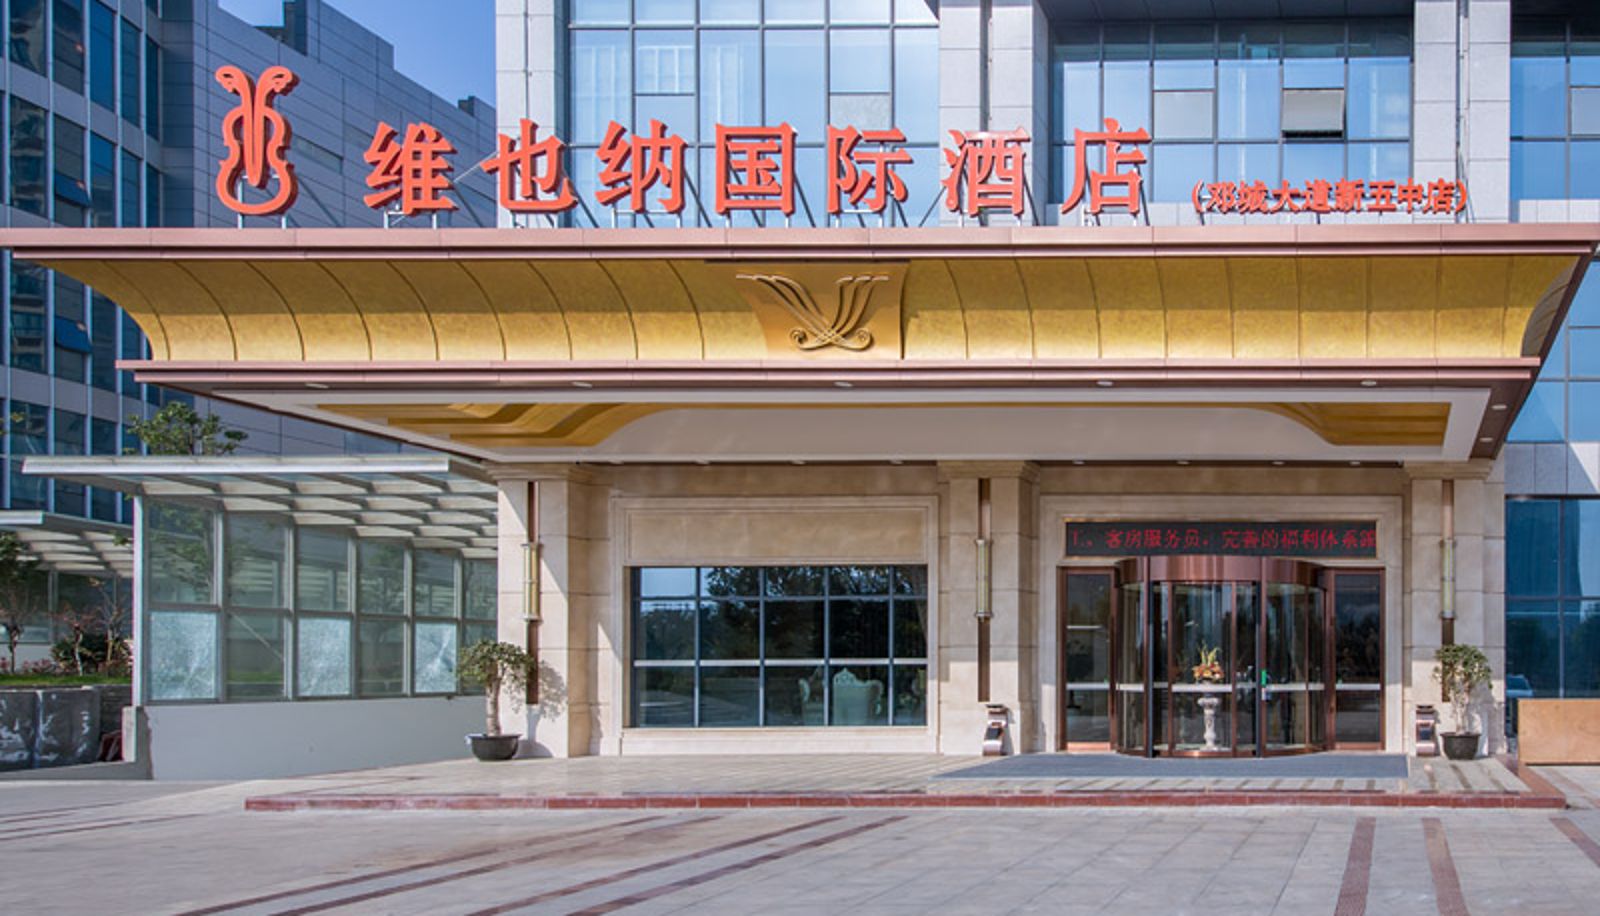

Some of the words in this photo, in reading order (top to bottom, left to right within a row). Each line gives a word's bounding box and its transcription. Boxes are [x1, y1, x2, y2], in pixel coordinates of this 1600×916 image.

[364, 118, 1152, 217] 维也纳国际酒店
